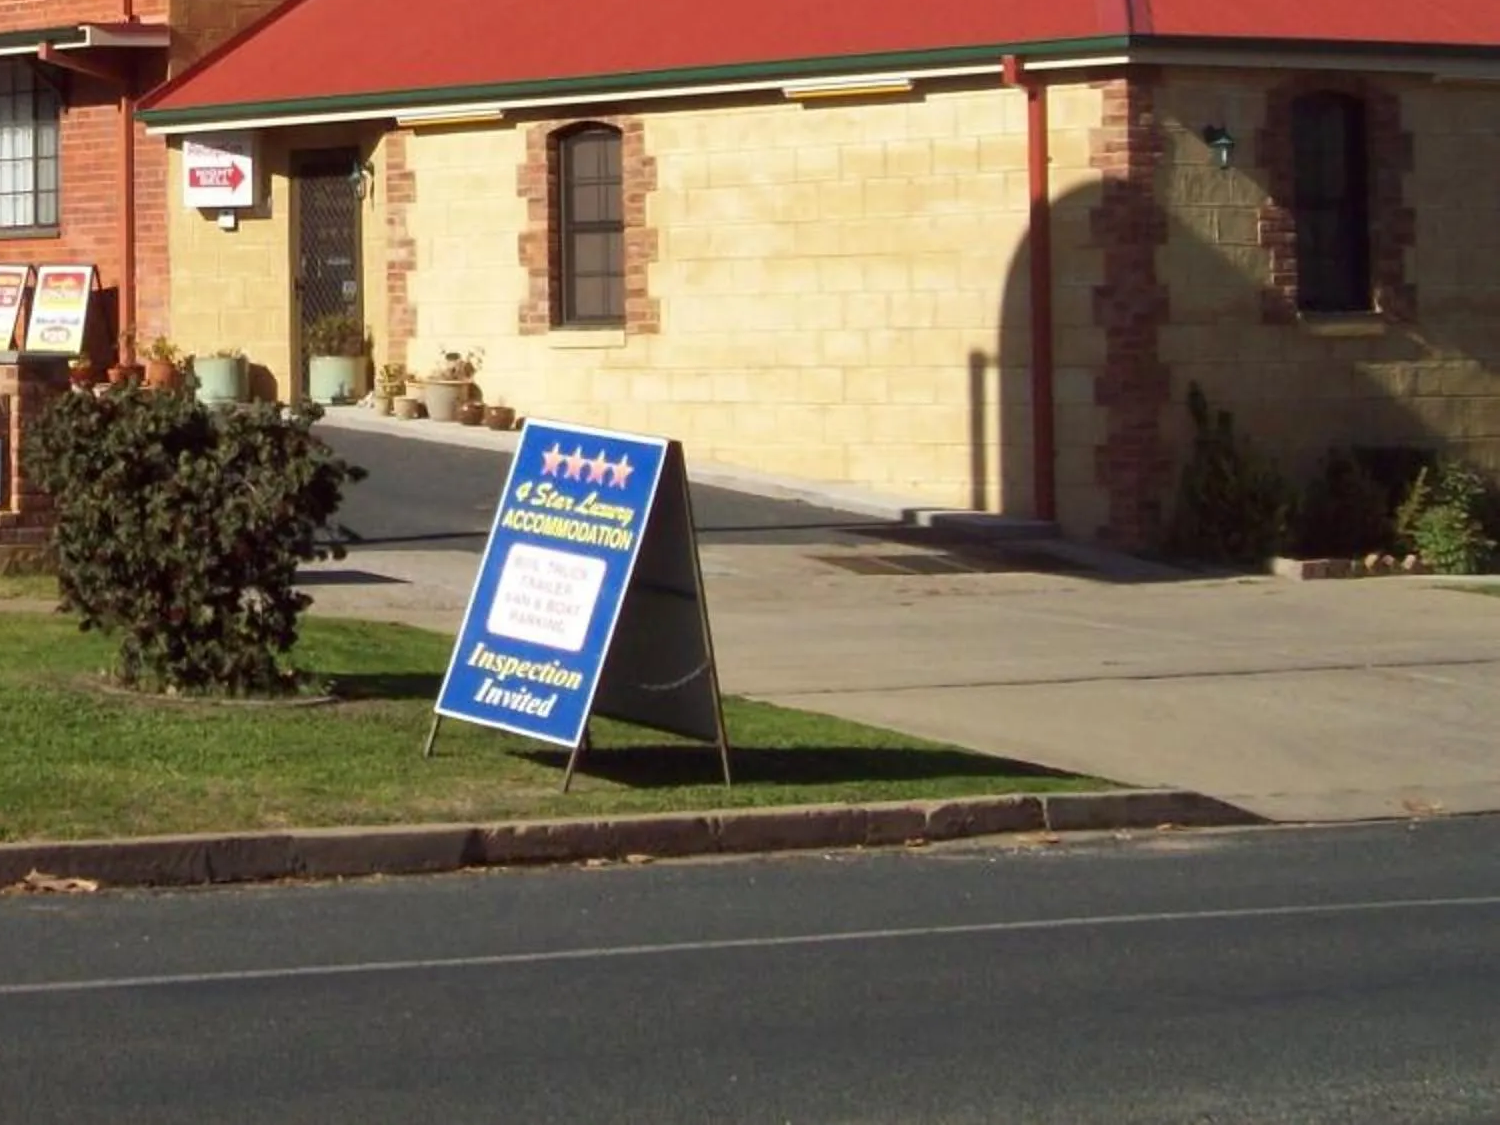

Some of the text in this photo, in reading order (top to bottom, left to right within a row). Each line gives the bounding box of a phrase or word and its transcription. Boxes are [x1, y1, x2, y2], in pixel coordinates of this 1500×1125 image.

[530, 481, 575, 512] Star
[573, 490, 636, 528] Luxury
[501, 507, 634, 552] ACCOMMODATION
[467, 642, 584, 692] Inspection
[473, 678, 558, 720] Invited
